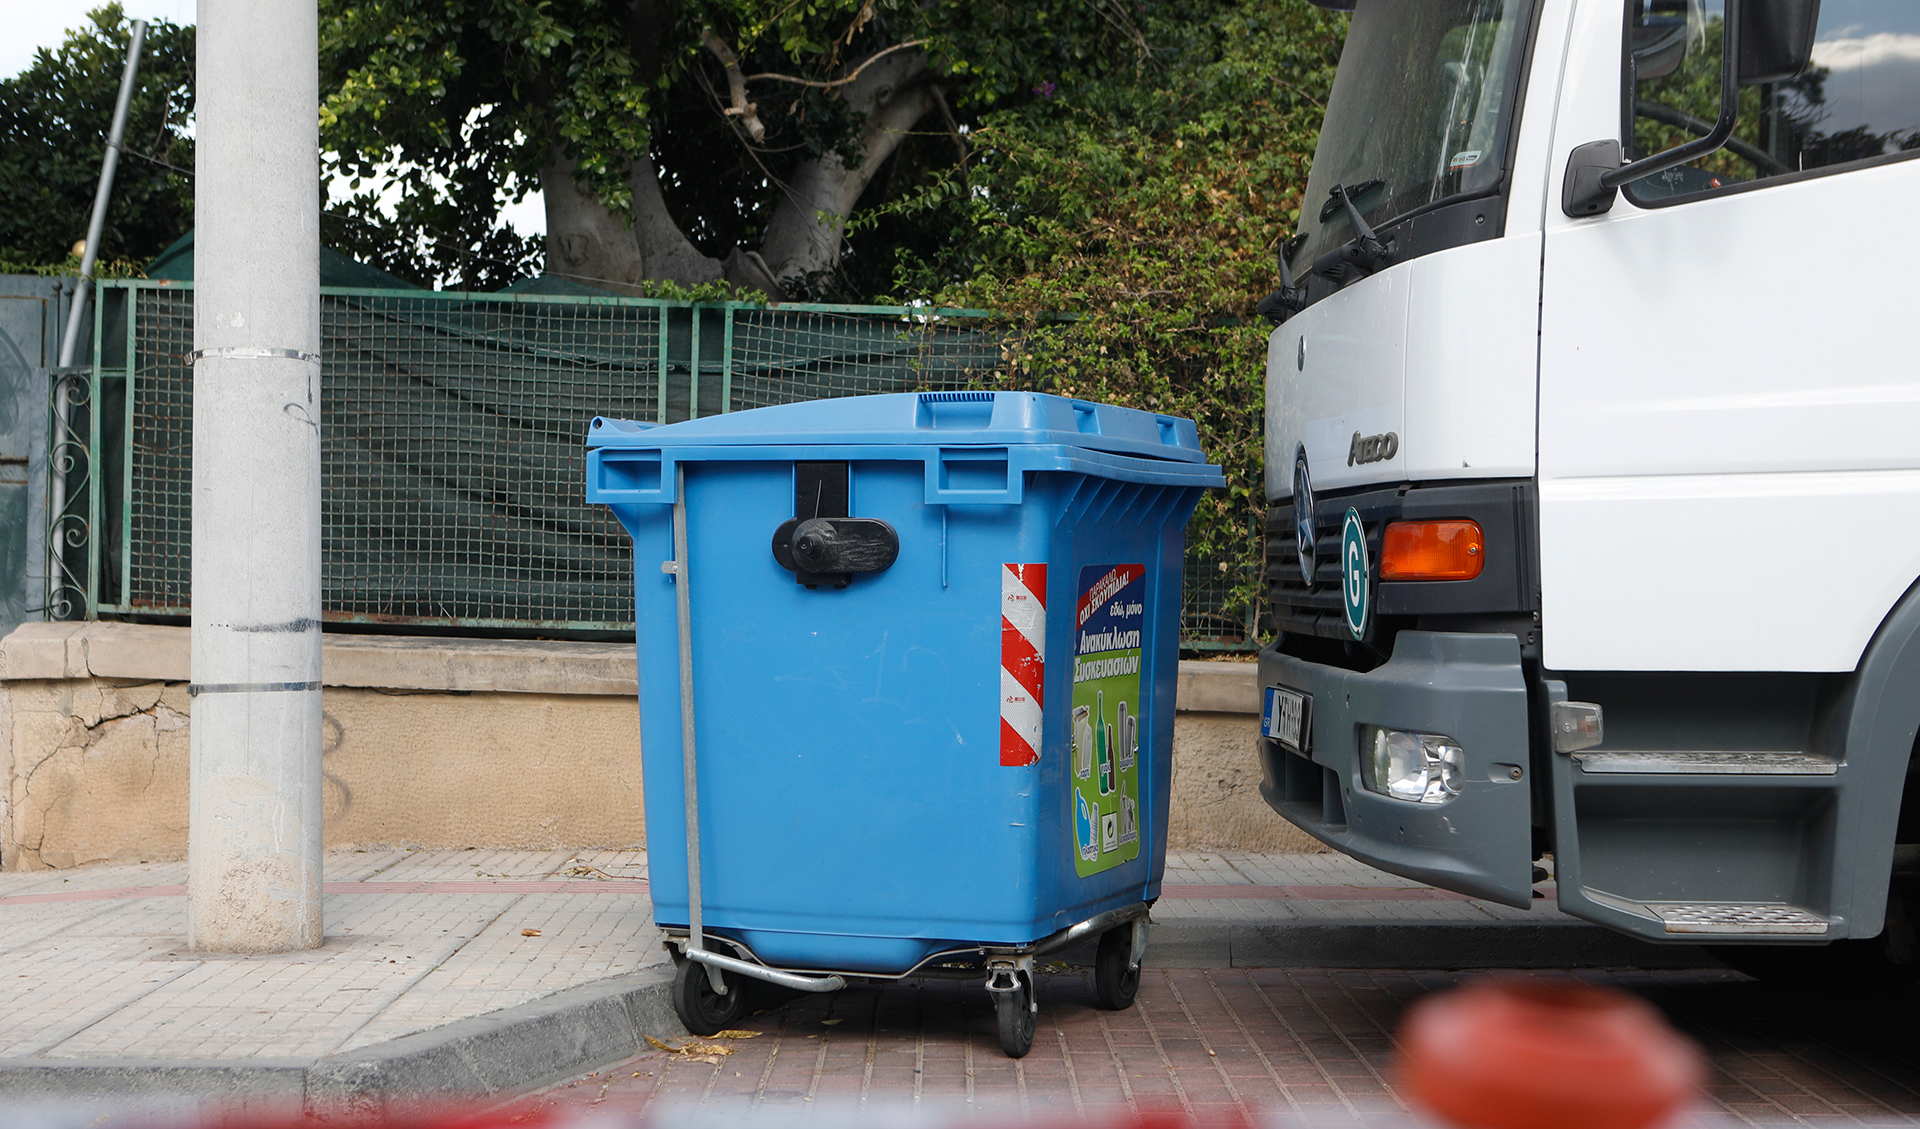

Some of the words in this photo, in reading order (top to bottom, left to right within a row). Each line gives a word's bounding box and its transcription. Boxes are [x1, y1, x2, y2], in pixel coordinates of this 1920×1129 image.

[1348, 540, 1361, 608] G
[1091, 570, 1130, 615] ΣΚΟΥΠΙΔΙΑ!
[1125, 599, 1143, 619] μόνο
[1079, 626, 1140, 655] Ανακύκλωση
[1073, 650, 1140, 683] Συσκευασιών
[1263, 716, 1271, 728] GR
